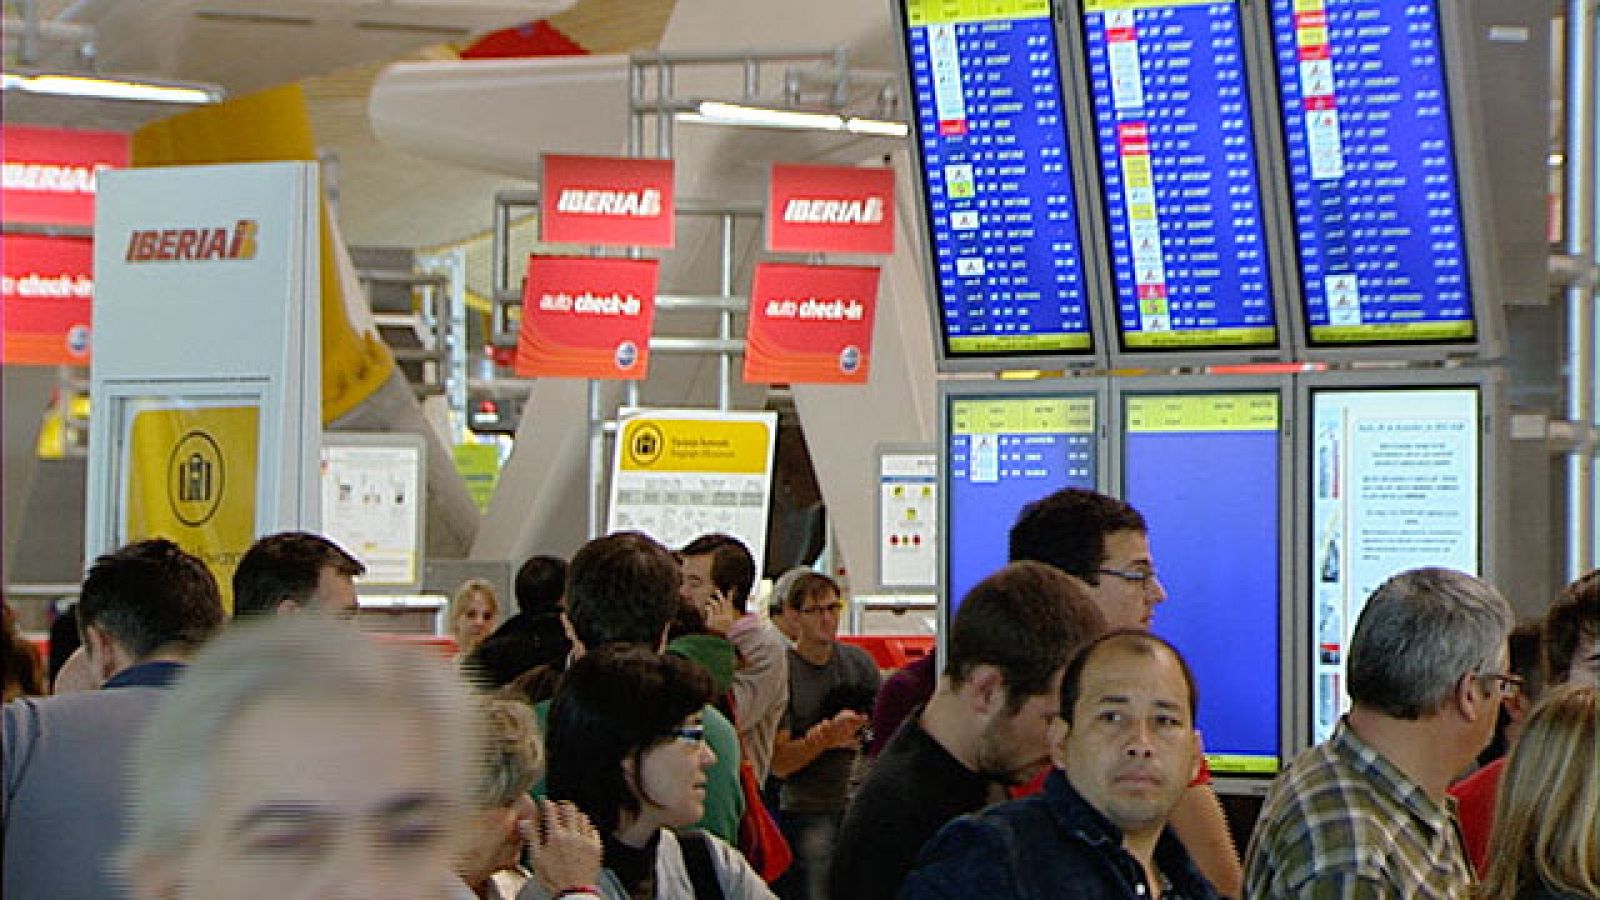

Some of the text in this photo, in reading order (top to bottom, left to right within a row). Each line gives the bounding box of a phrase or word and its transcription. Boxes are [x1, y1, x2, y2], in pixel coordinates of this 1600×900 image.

[558, 190, 638, 214] IBERIA
[785, 199, 861, 222] IBERIA
[126, 229, 228, 261] IBERIA
[540, 292, 640, 316] auto check-in
[766, 297, 863, 320] auto check-in
